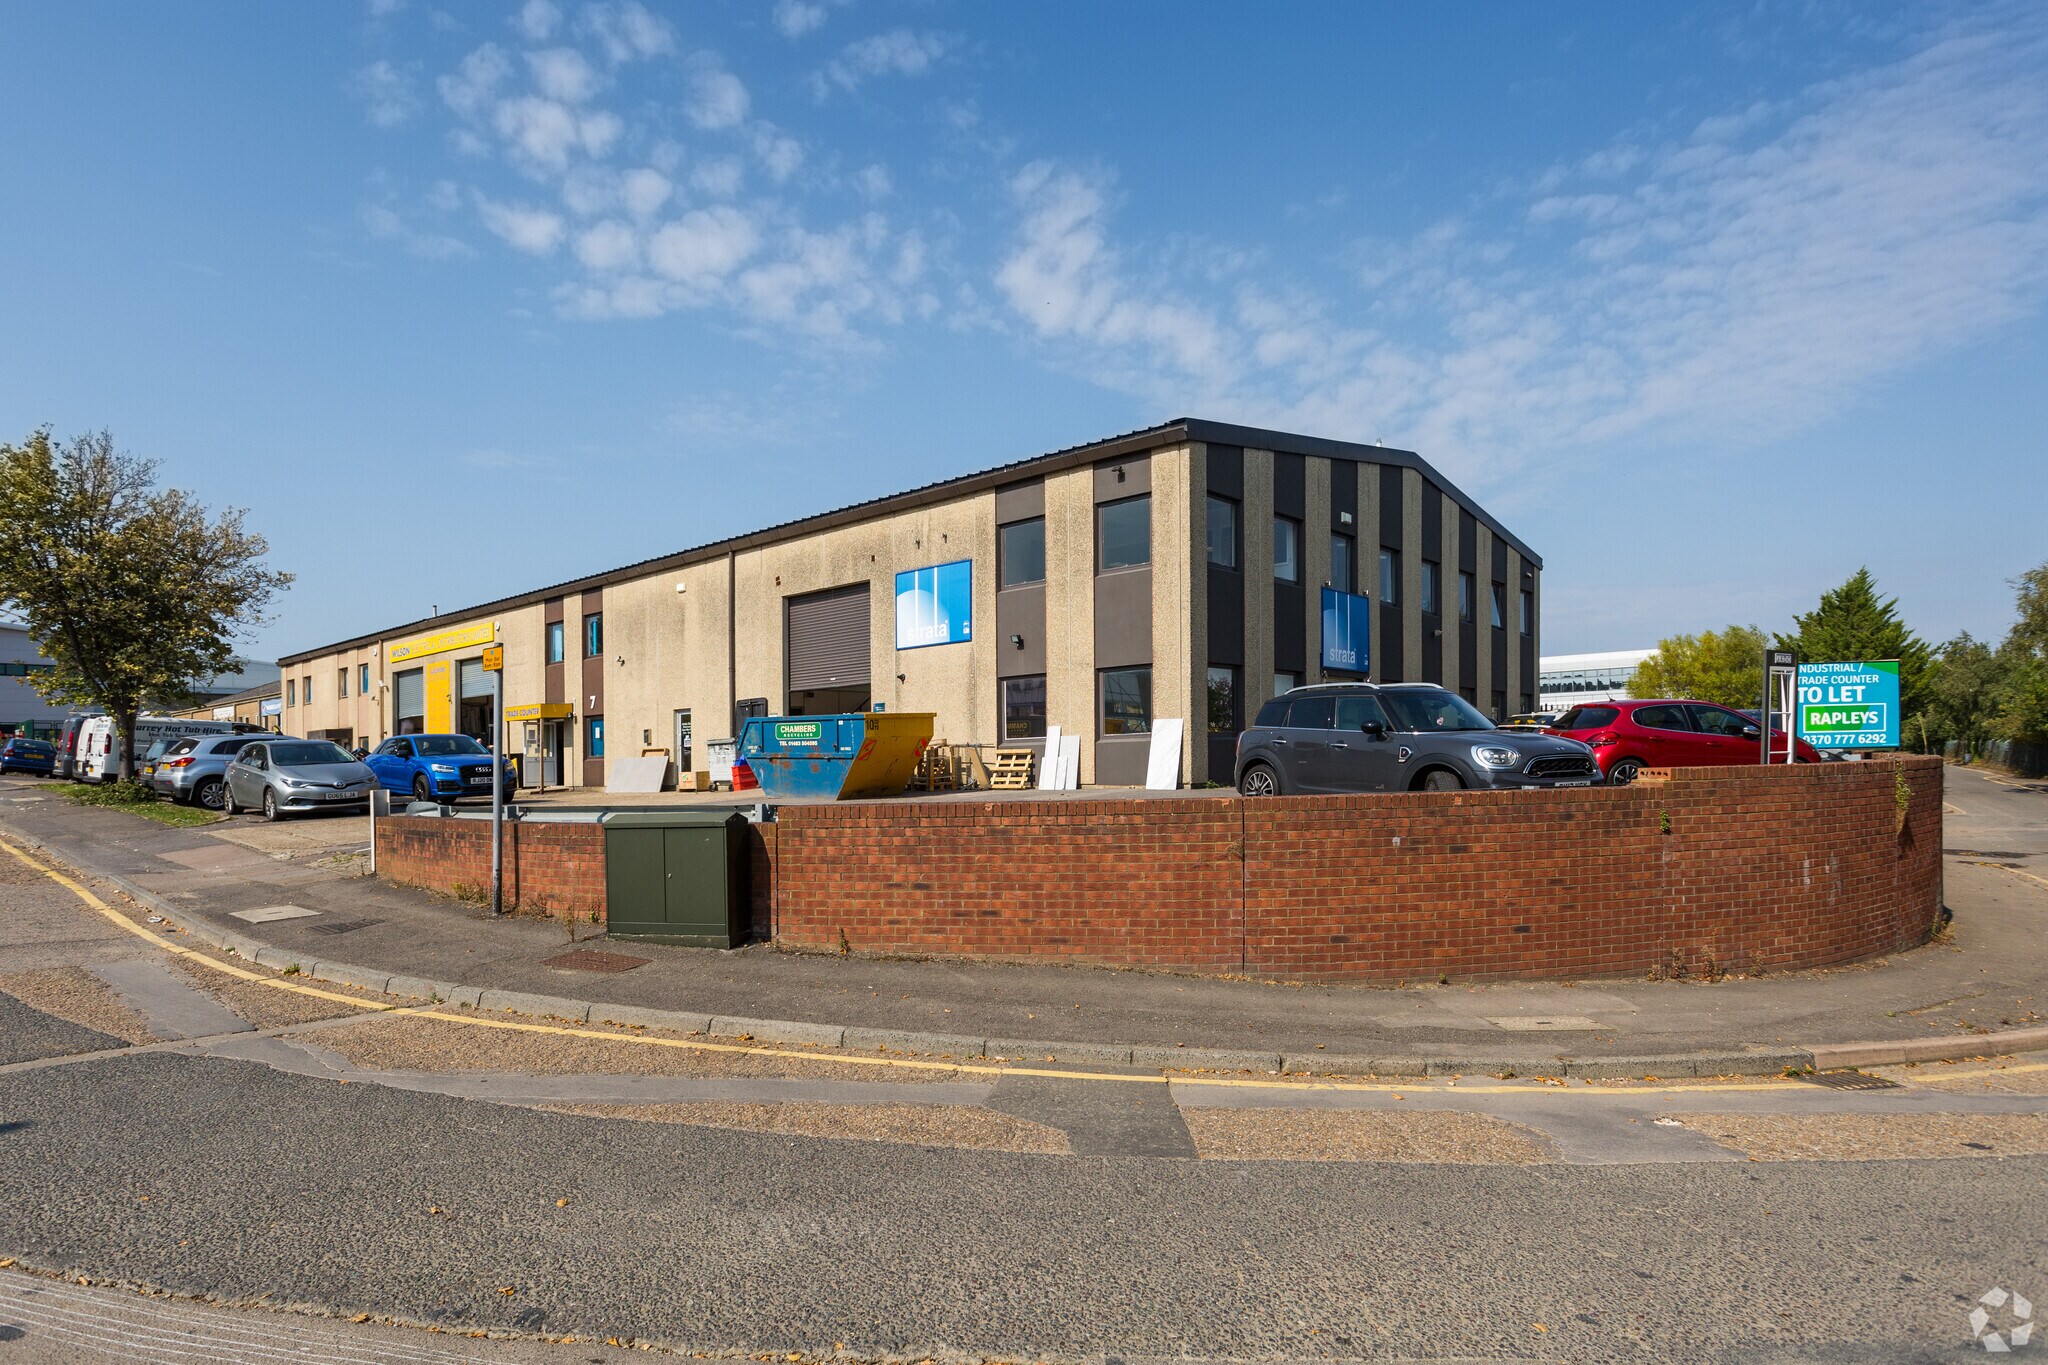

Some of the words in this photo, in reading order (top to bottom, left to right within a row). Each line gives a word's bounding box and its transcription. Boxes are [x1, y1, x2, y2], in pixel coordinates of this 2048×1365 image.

[906, 622, 948, 641] strata
[391, 646, 410, 658] WILSON
[1330, 648, 1356, 664] strata
[1799, 663, 1856, 673] NDUSTRIAL
[1798, 675, 1829, 685] TRADE
[1831, 674, 1879, 684] COUNTER
[1798, 686, 1823, 703] TO
[1828, 685, 1866, 703] LET
[589, 695, 596, 709] 7
[505, 709, 519, 717] TRADE
[520, 707, 539, 717] COUNTER
[1810, 711, 1879, 725] RAPLEYS
[136, 725, 162, 733] urrey
[164, 725, 182, 733] Hot
[184, 726, 201, 734] Tub
[202, 727, 223, 735] Hire
[780, 724, 817, 734] CHAMBERS
[865, 719, 875, 731] 10
[1803, 735, 1832, 745] 0370
[1834, 734, 1856, 744] 777
[1858, 733, 1887, 744] 6292
